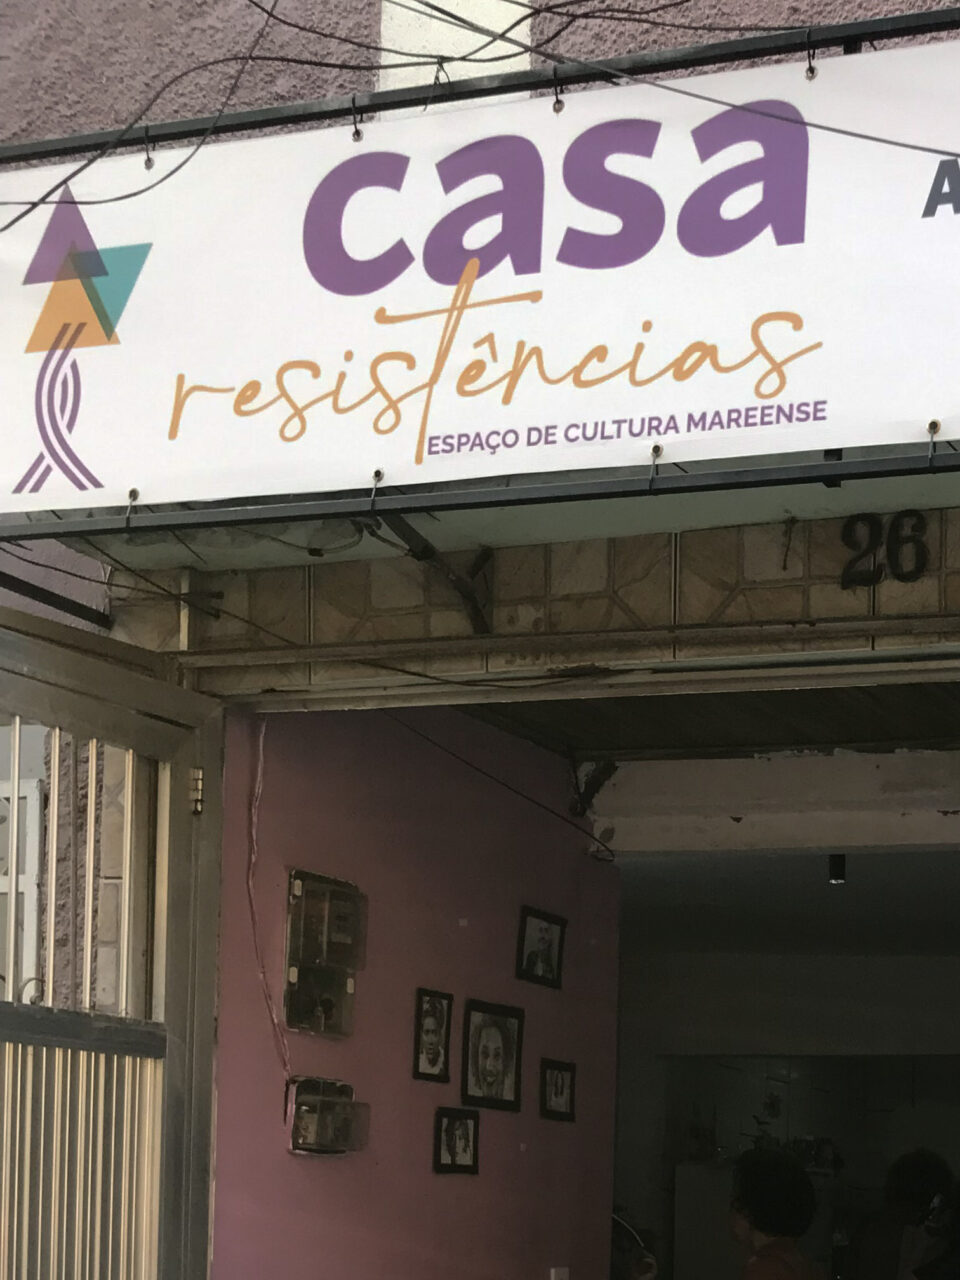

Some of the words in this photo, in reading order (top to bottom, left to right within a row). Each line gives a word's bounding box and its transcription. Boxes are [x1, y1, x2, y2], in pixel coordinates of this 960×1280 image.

[302, 97, 811, 297] casa
[168, 257, 824, 465] resistências
[427, 429, 519, 455] ESPAÇO
[526, 425, 558, 447] DE
[564, 415, 680, 442] CULTURA
[686, 400, 828, 432] MAREENSE
[841, 509, 929, 591] 26
